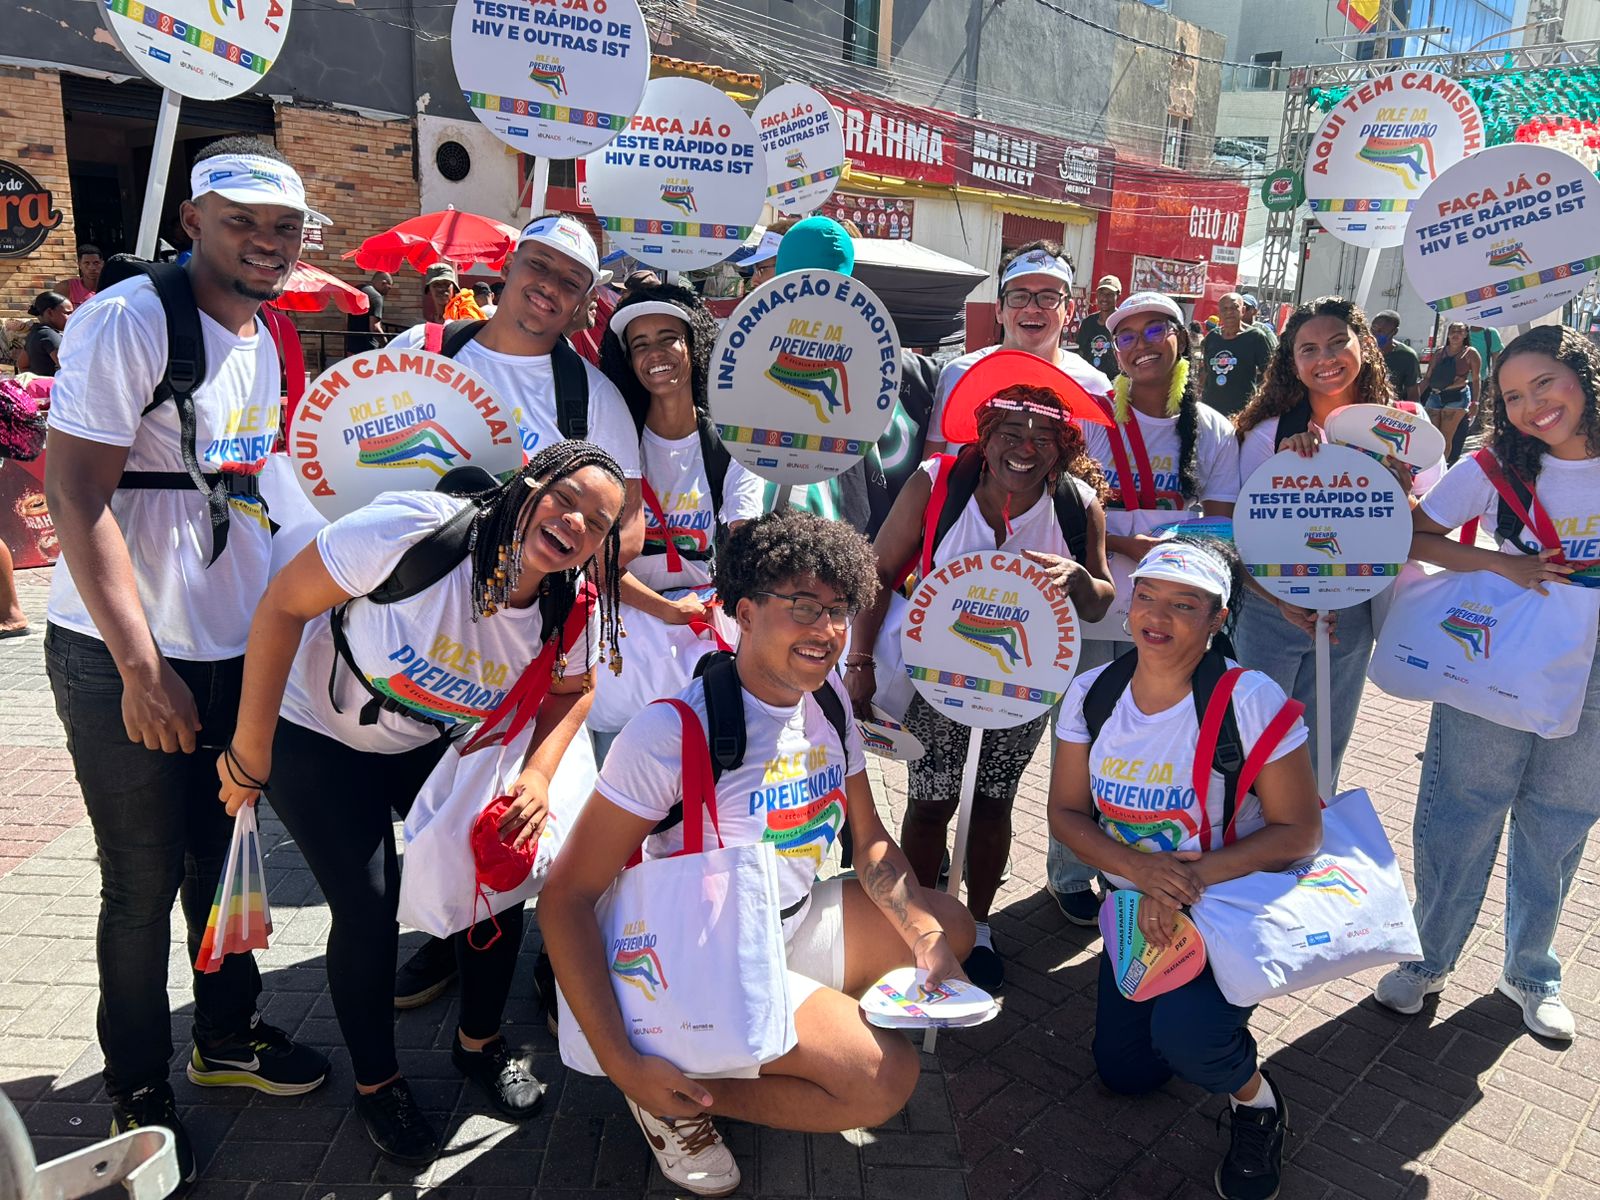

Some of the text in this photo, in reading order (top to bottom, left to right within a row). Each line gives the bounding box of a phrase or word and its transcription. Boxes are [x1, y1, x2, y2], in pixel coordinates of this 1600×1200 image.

[474, 0, 631, 39] TESTE RÁPIDO DE
[593, 0, 607, 13] O
[472, 19, 630, 58] HIV E OUTRAS IST
[630, 116, 731, 138] FAÇA JÁ O
[761, 103, 813, 130] FAÇA JÁ O
[780, 116, 813, 138] RÁPIDO
[816, 111, 828, 123] DE
[1312, 72, 1481, 175] AQUI TEM CAMISINH
[1409, 107, 1429, 122] DA
[663, 136, 726, 155] RÁPIDO
[729, 144, 754, 158] DE
[770, 141, 776, 151] E
[778, 131, 814, 148] OUTRAS
[816, 123, 830, 136] IST
[973, 130, 1038, 168] MINI
[605, 152, 753, 174] HIV E OUTRAS IST
[972, 162, 1036, 187] MARKET
[1438, 172, 1552, 218] FAÇA JÁ O
[1189, 205, 1239, 242] GELO AR
[1416, 179, 1584, 241] TESTE RÁPIDO DE
[1420, 196, 1586, 256] HIV E OUTRAS IST
[718, 274, 898, 410] INFORMAÇÃO É PROTEÇÃO
[824, 324, 844, 342] DA
[299, 370, 350, 423] TEM
[352, 353, 512, 445] CAMISINHA!
[392, 390, 414, 410] DA
[296, 431, 337, 497] AQUI
[1272, 472, 1369, 491] FAÇA JÁ O
[1250, 489, 1393, 504] TESTE RÁPIDO DE
[1250, 506, 1394, 520] HIV E OUTRAS IST
[1001, 592, 1019, 605] DA
[906, 555, 1075, 671] AQUI TEM CAMISINHA!
[388, 644, 508, 711] PREVENÇÃ
[1145, 762, 1175, 784] DA
[1127, 898, 1135, 946] CAMISINHAS
[1175, 937, 1187, 951] PEP
[1164, 950, 1196, 976] TRATAMENTO
